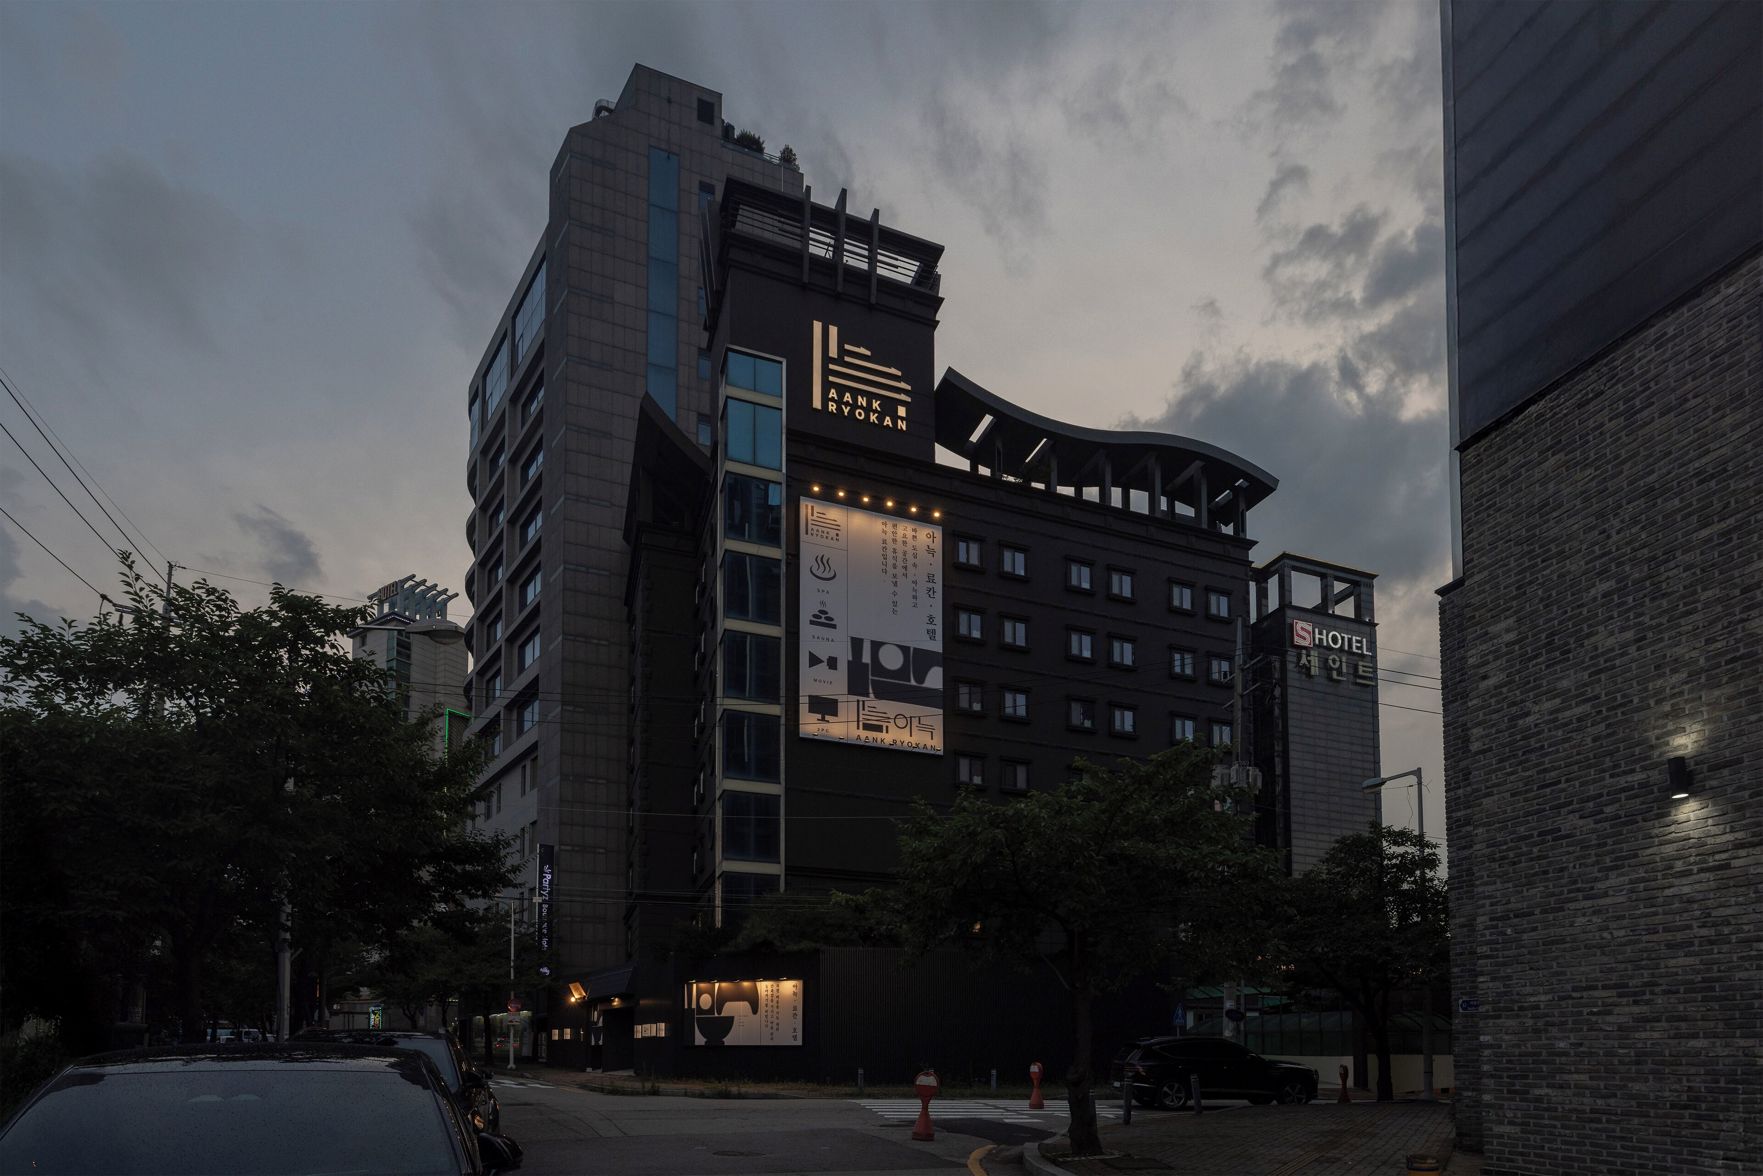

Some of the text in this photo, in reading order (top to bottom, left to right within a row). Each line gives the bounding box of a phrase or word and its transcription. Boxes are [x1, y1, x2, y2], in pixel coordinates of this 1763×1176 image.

[828, 388, 881, 411] AANK
[828, 401, 907, 431] RYOKAN
[925, 531, 937, 641] 아늑 료칸 호텔
[1314, 627, 1372, 656] HOTEL
[1298, 650, 1376, 686] 세인트
[855, 734, 936, 751] AANK RYOKAN
